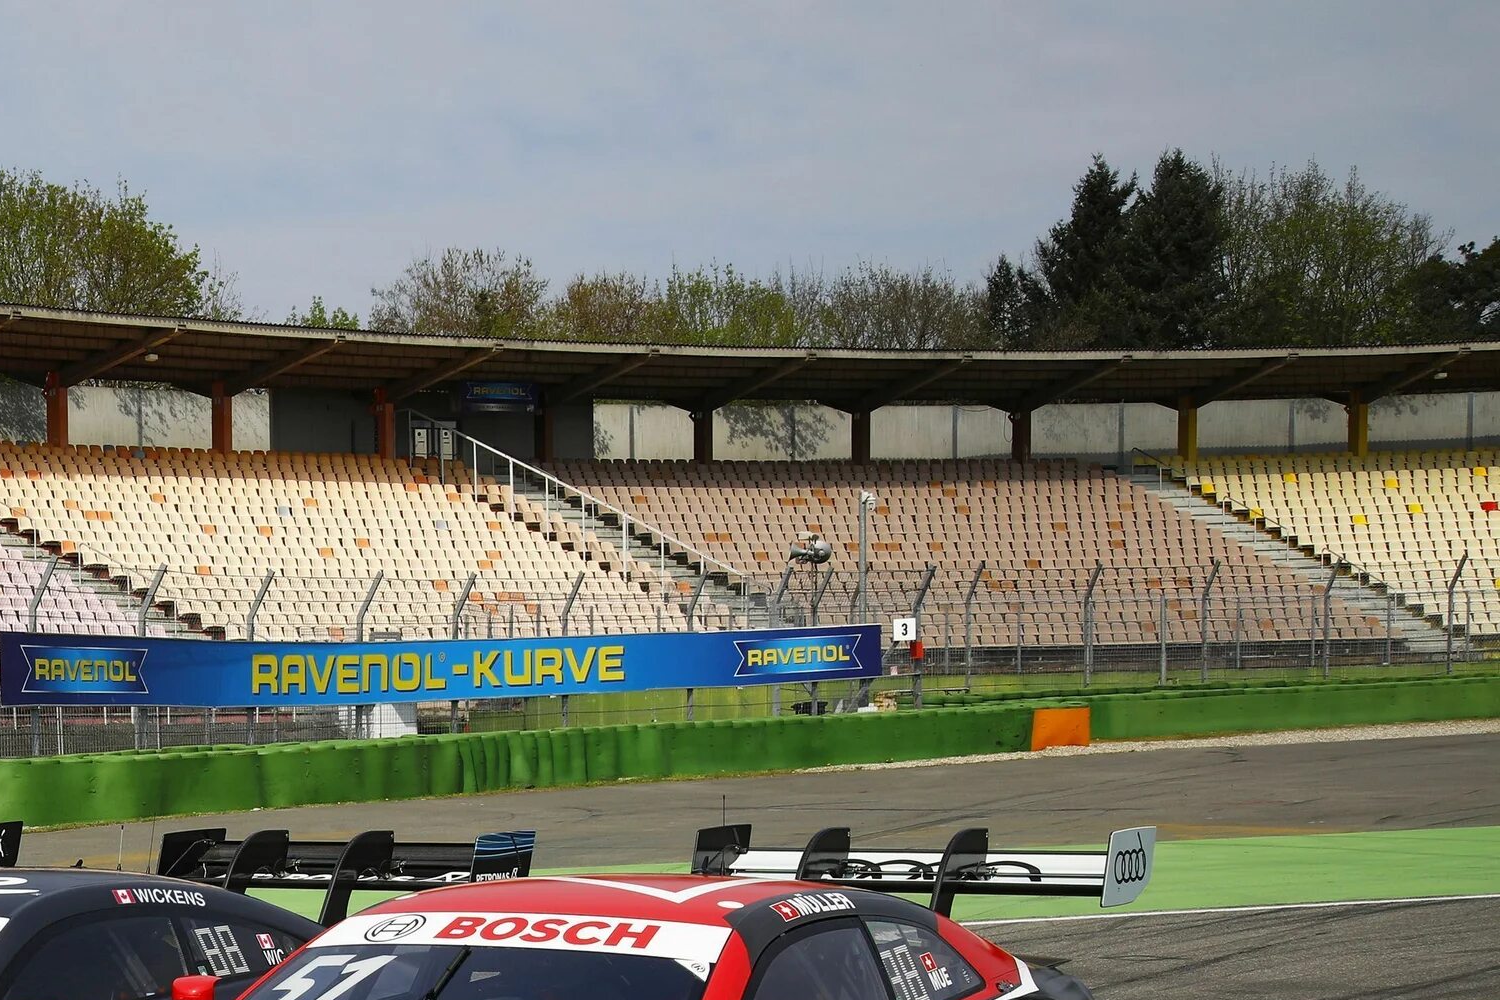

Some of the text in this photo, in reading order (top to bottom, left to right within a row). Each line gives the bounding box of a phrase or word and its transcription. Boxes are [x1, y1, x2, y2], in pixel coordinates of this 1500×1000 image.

[900, 622, 909, 636] 3
[746, 643, 850, 666] RAVENOL
[34, 658, 136, 682] RAVENOL
[133, 888, 206, 907] WICKENS
[786, 892, 856, 917] MÜLLER
[434, 915, 661, 950] BOSCH
[927, 966, 953, 992] MUE
